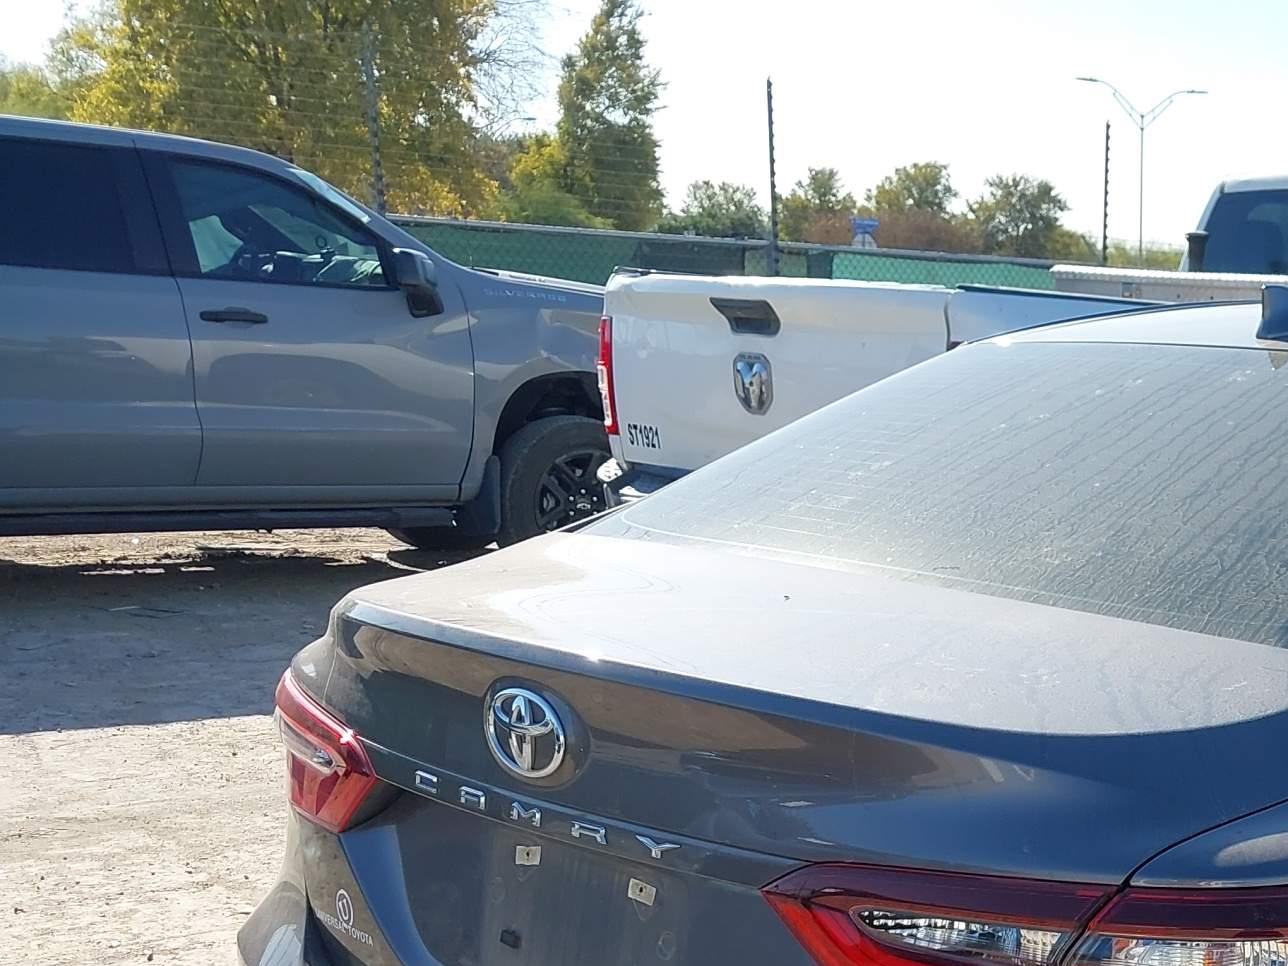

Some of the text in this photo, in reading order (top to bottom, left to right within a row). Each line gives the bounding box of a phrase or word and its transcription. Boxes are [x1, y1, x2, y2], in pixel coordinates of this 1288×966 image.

[627, 423, 661, 449] ST1921
[414, 769, 682, 860] CAMRY
[347, 925, 374, 947] TOYOTA
